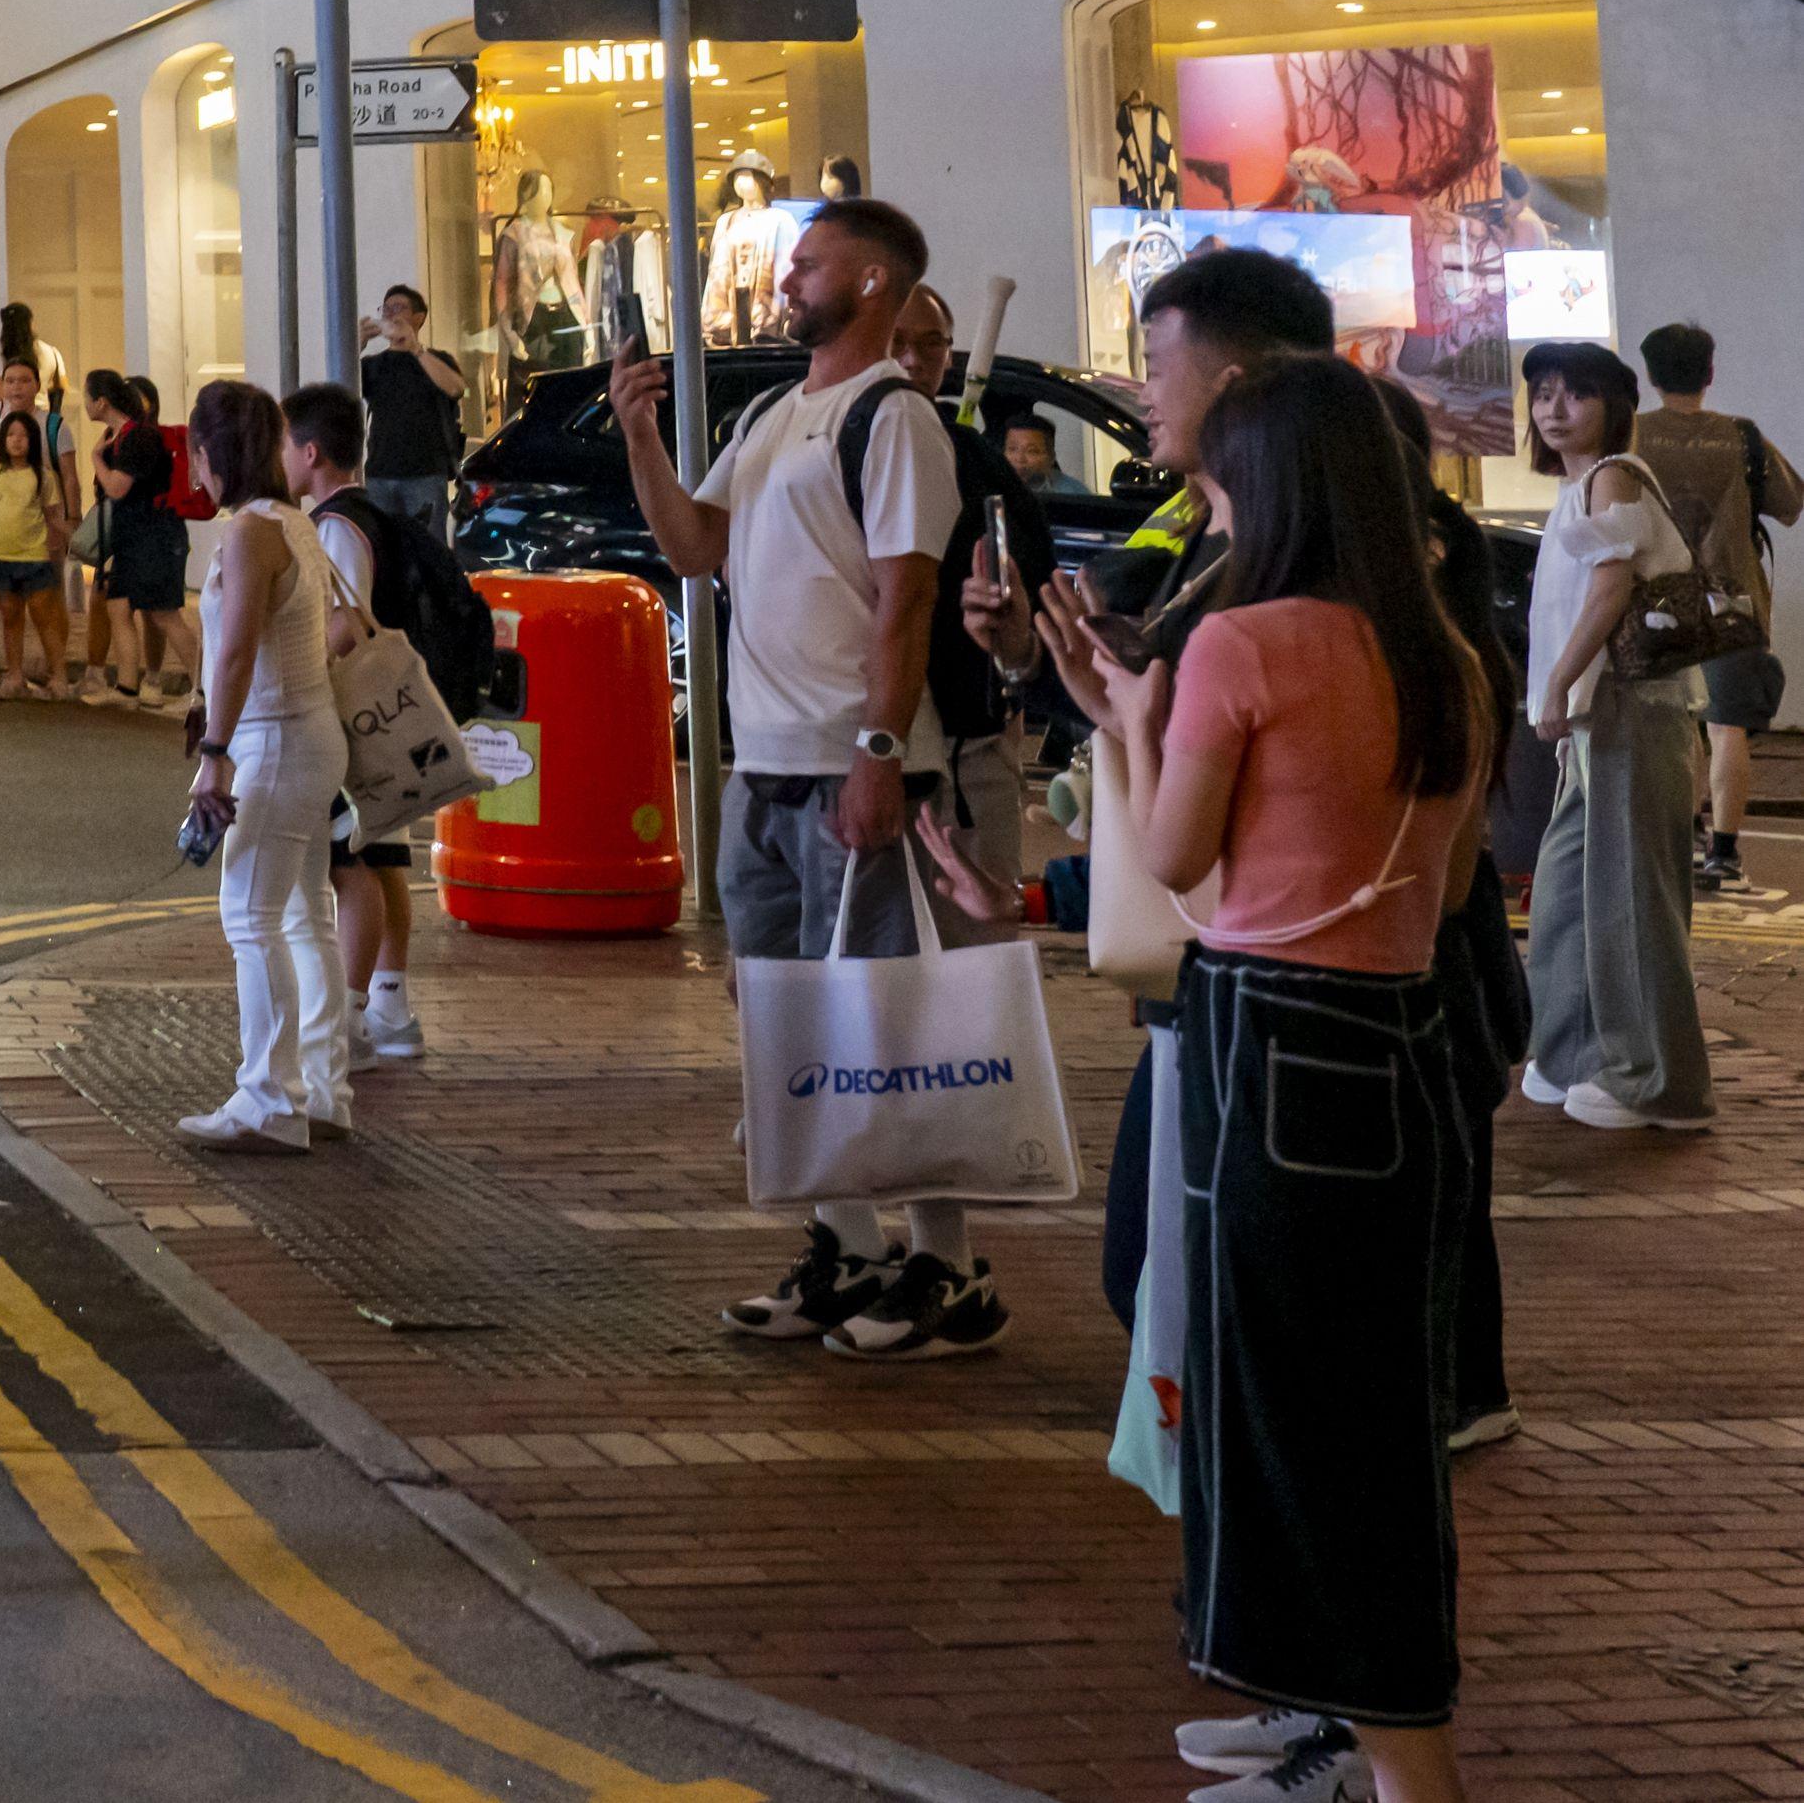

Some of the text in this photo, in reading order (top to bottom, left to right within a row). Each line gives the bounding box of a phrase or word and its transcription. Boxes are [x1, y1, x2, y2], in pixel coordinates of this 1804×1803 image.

[564, 40, 719, 84] INITIL
[378, 79, 422, 94] Road
[412, 107, 445, 120] 20-2
[833, 1057, 1014, 1095] DECATHLON
